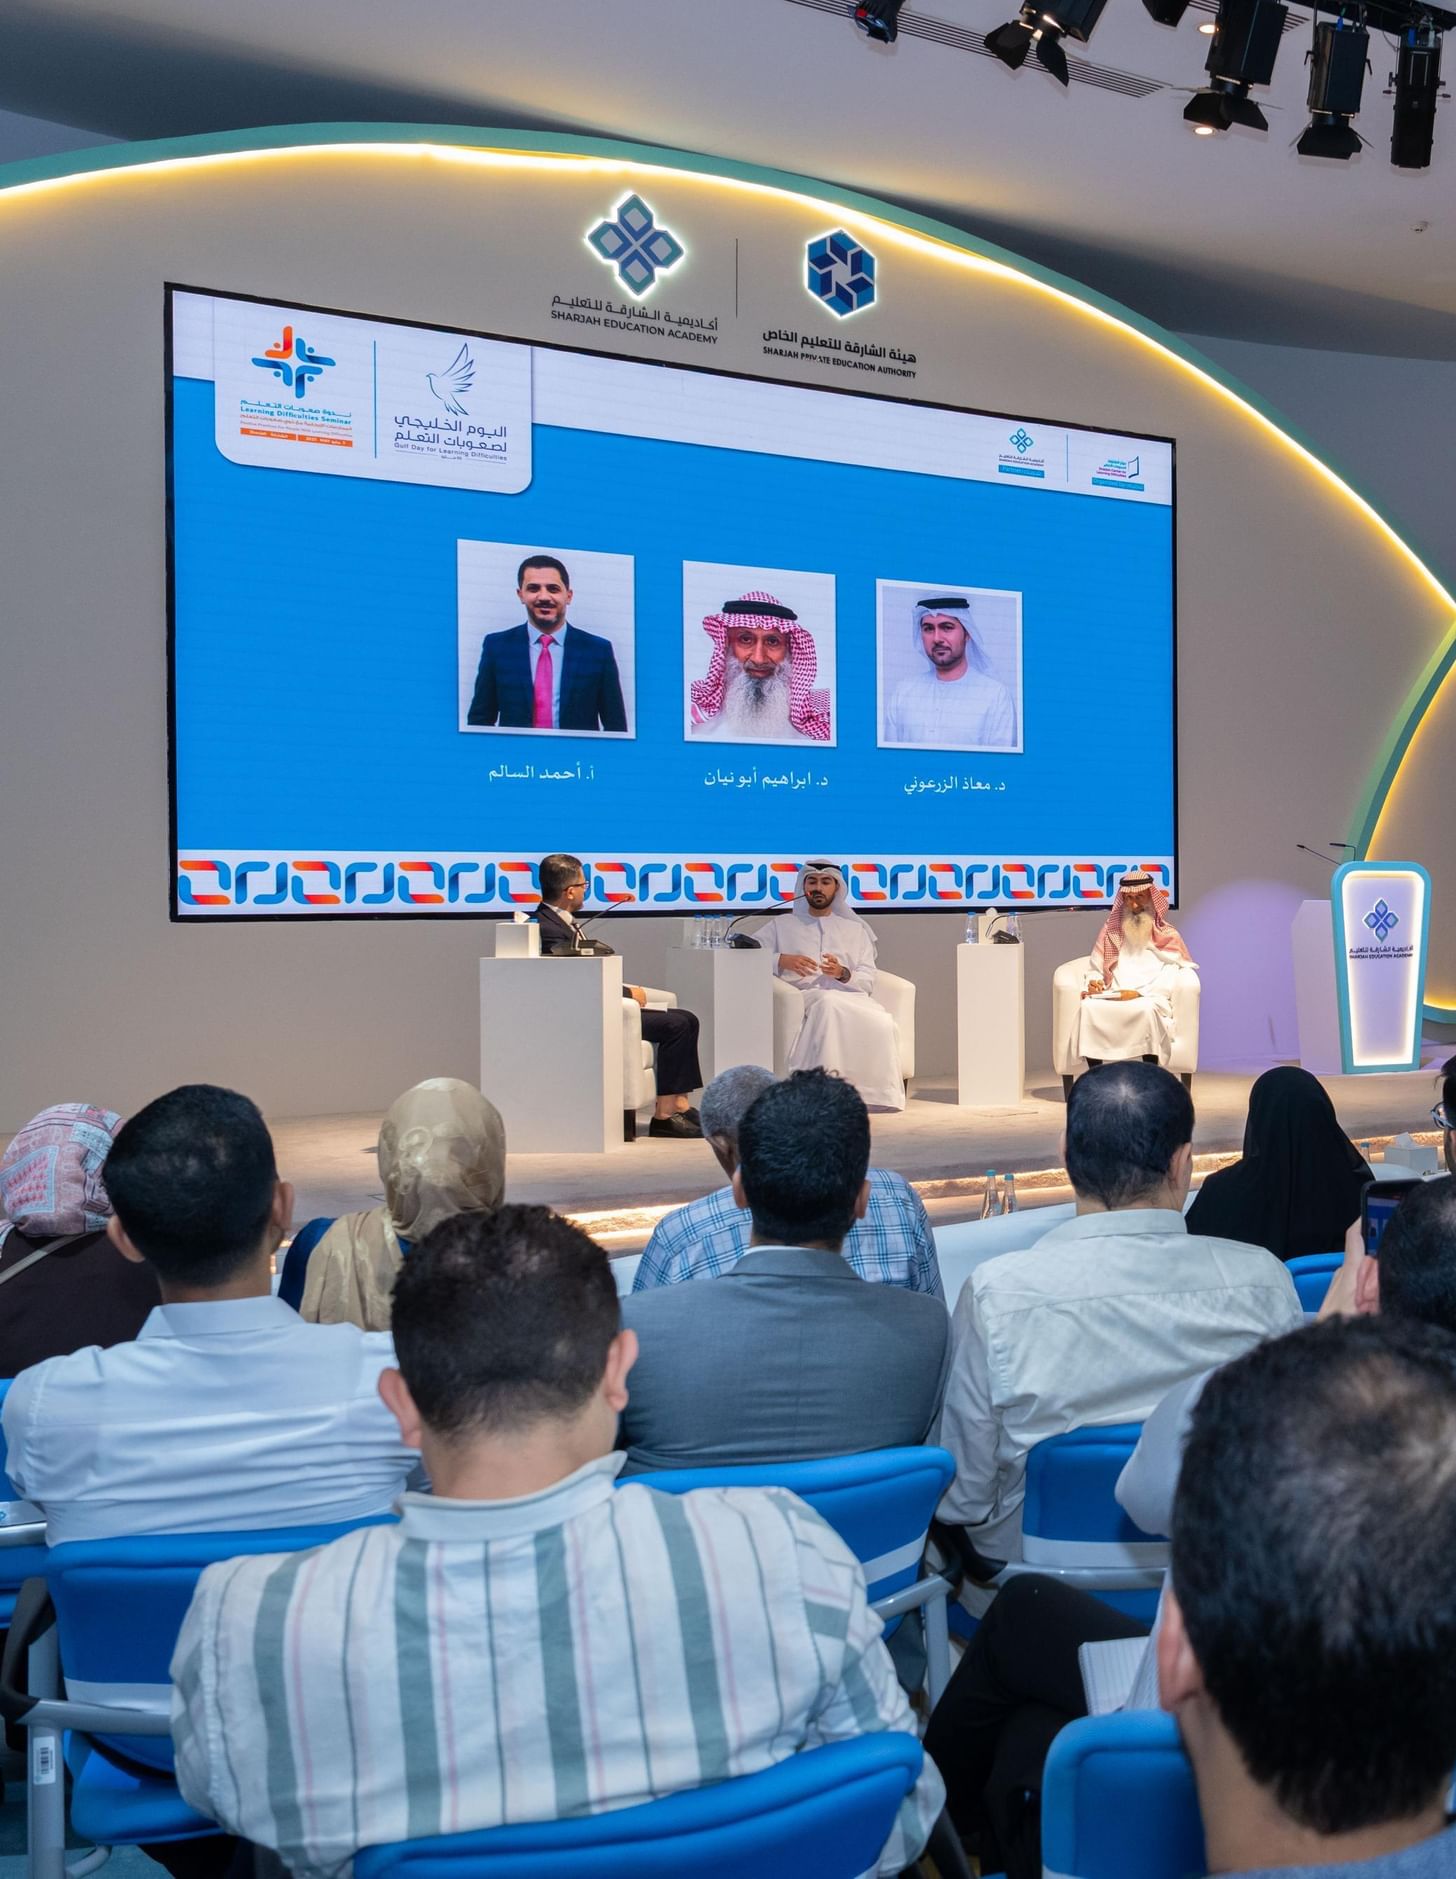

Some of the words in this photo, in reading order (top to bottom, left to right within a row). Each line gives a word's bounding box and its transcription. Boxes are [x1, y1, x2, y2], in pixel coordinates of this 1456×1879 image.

[552, 295, 602, 311] للتعليم
[606, 301, 660, 320] الشارقة
[551, 310, 601, 326] SHARJAH
[603, 318, 665, 336] EDUCATION
[667, 329, 719, 344] ACADEMY
[664, 312, 718, 331] أكاديمية
[763, 330, 798, 343] الخاص
[801, 336, 842, 350] للتعليم
[844, 341, 886, 358] الشارقة
[889, 348, 917, 365] هيئة
[763, 346, 799, 359] SHARJAH
[832, 357, 876, 372] EDUCATION
[877, 365, 917, 379] AUTHORITY
[240, 406, 275, 417] Learning
[277, 411, 319, 421] Difficulties
[321, 416, 352, 425] Seminar
[394, 415, 462, 432] الخليجي
[395, 430, 440, 444] التعلم
[466, 425, 507, 438] اليوم
[411, 444, 425, 452] Day
[439, 448, 469, 457] Learning
[471, 451, 508, 461] Difficulties
[444, 435, 507, 453] لصعوبات
[489, 764, 535, 782] السالم
[539, 761, 581, 780] أحمد
[762, 770, 811, 791] ابراهيم
[816, 776, 829, 786] د.
[904, 776, 958, 795] الزرعوني
[962, 776, 991, 791] معاذ
[995, 781, 1006, 791] د.
